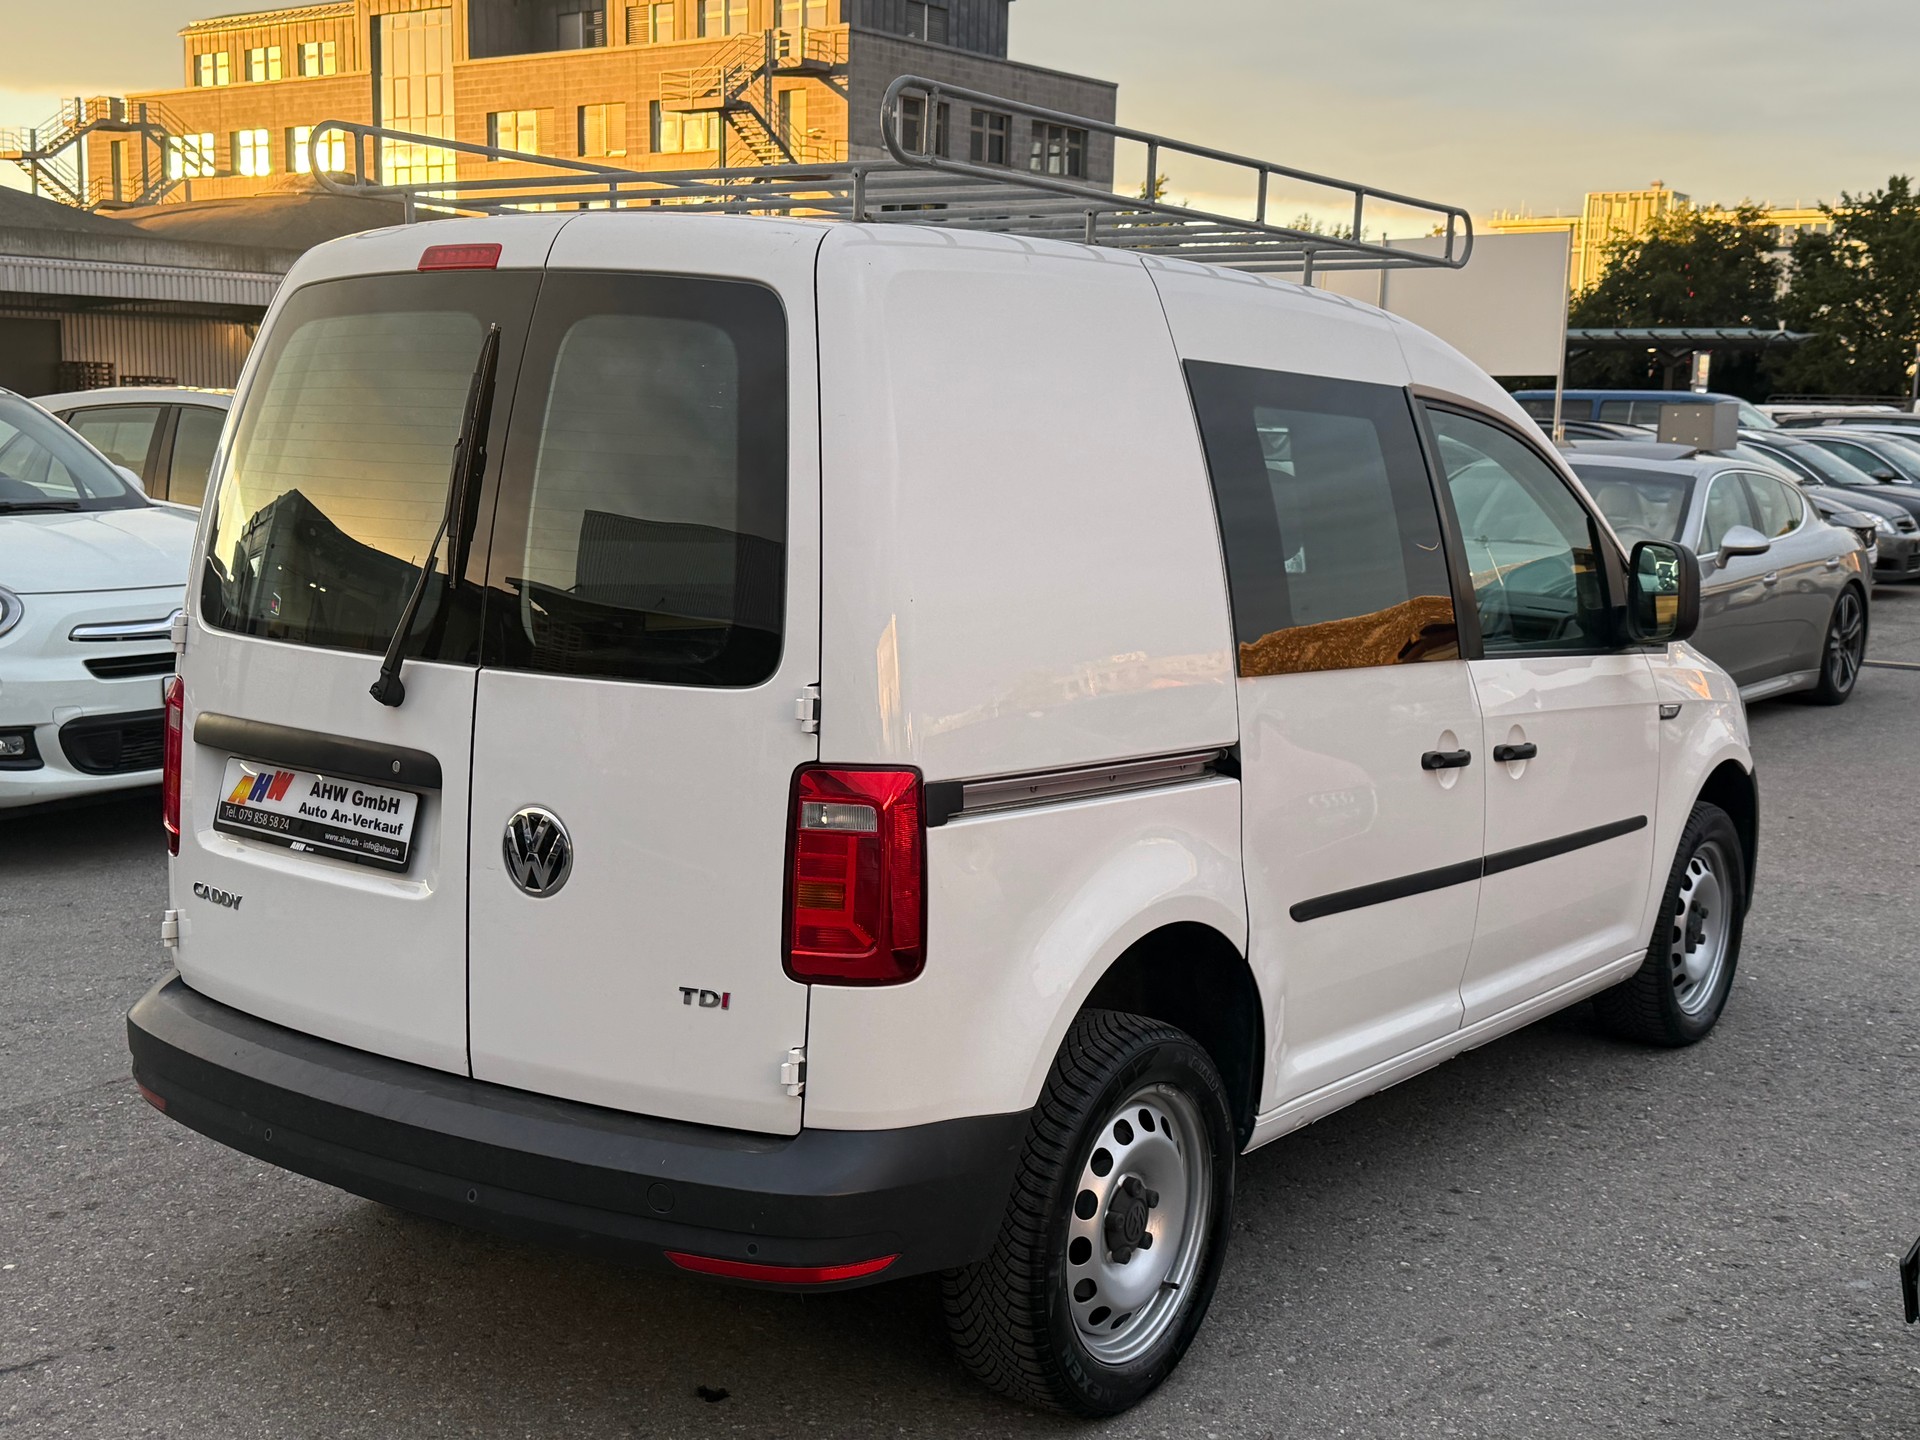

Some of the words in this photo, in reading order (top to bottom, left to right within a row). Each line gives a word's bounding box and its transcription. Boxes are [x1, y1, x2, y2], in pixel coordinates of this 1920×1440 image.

[228, 770, 295, 804] AHW
[310, 782, 349, 803] AHW
[352, 790, 400, 814] GmbH
[226, 806, 236, 818] Tel.
[238, 809, 252, 822] 079
[254, 812, 268, 825] 858
[269, 816, 279, 828] 58
[280, 818, 290, 830] 24
[298, 802, 328, 818] Auto
[330, 809, 404, 835] An-Verkauf
[324, 833, 358, 846] www.ahw.ch
[363, 840, 399, 856] info@ahw.ch
[193, 881, 244, 910] CADDY
[678, 986, 732, 1010] TDI
